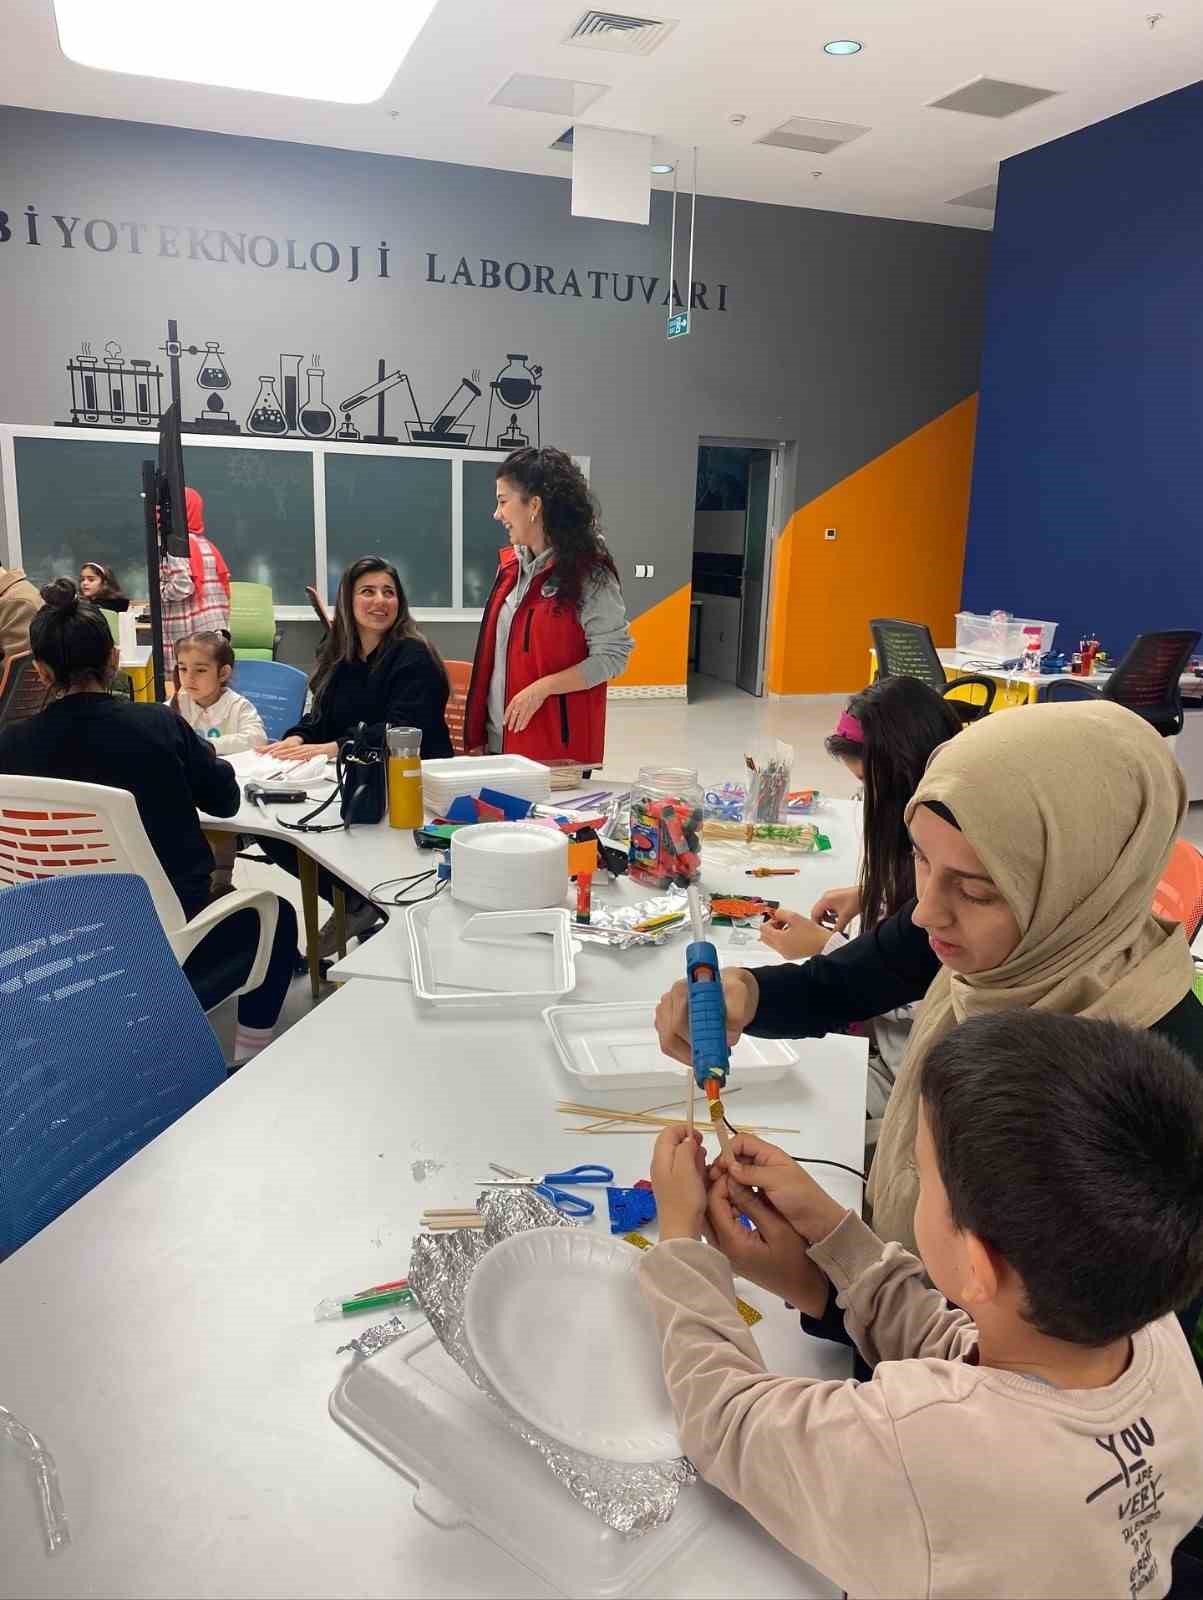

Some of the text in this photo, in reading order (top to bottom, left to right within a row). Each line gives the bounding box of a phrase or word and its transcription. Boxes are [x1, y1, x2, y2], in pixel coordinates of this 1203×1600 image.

[425, 252, 729, 312] LABORATUVARI
[1096, 1417, 1155, 1488] YOU
[1136, 1465, 1154, 1487] ARE
[1118, 1473, 1164, 1520] VERY
